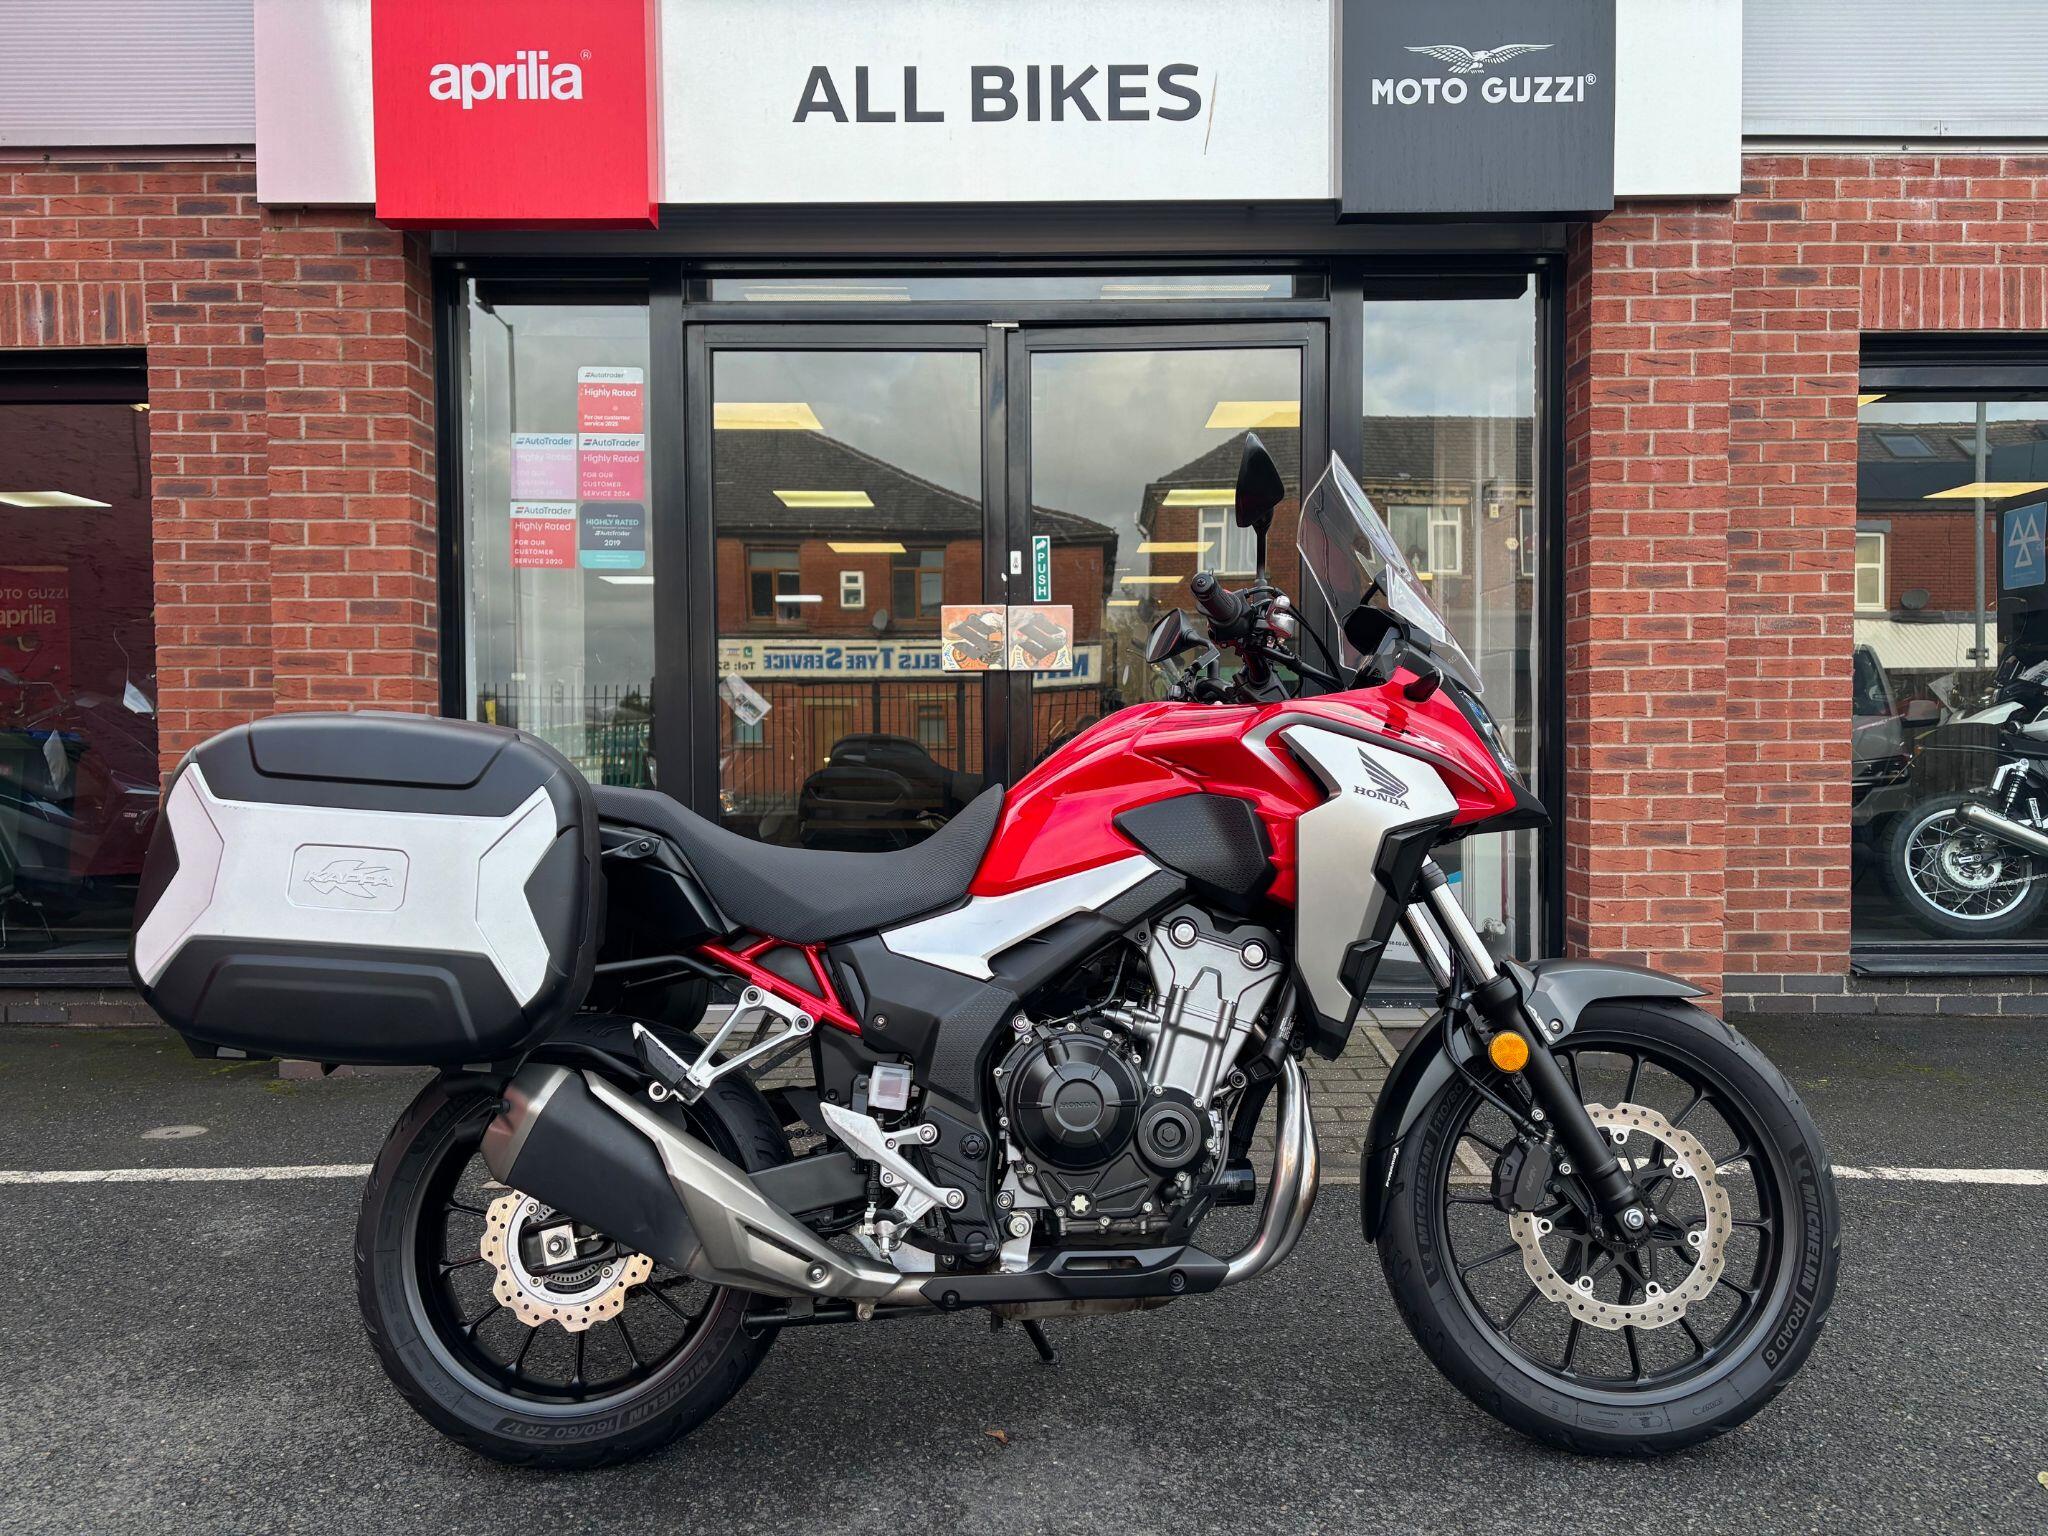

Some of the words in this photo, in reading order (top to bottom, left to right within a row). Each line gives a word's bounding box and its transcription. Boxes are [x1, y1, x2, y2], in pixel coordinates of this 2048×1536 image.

[792, 65, 945, 123] ALL
[970, 63, 1202, 122] BIKES
[1371, 78, 1468, 105] MOTO
[584, 388, 610, 398] Highly
[611, 389, 637, 397] Rated
[525, 437, 573, 446] AutoTrader
[592, 438, 641, 447] AutoTrader
[583, 454, 611, 464] Highly
[612, 454, 640, 463] Rated
[582, 480, 622, 488] CUSTOMER
[524, 506, 572, 515] AutoTrader
[515, 521, 543, 532] Highly
[544, 522, 571, 531] Rated
[585, 518, 614, 526] HIGHLY
[614, 518, 640, 526] RATED
[604, 539, 621, 547] 2019
[1037, 552, 1047, 596] PUSH
[27, 588, 69, 599] GUZZI
[1353, 785, 1410, 810] HONDA
[1415, 1139, 1433, 1246] MICHELIN
[1801, 1183, 1823, 1292] MICHELIN
[1775, 1305, 1806, 1350] ROAD
[1769, 1350, 1779, 1366] 6
[628, 1358, 708, 1423] MICHELIN
[525, 1425, 549, 1439] ZR
